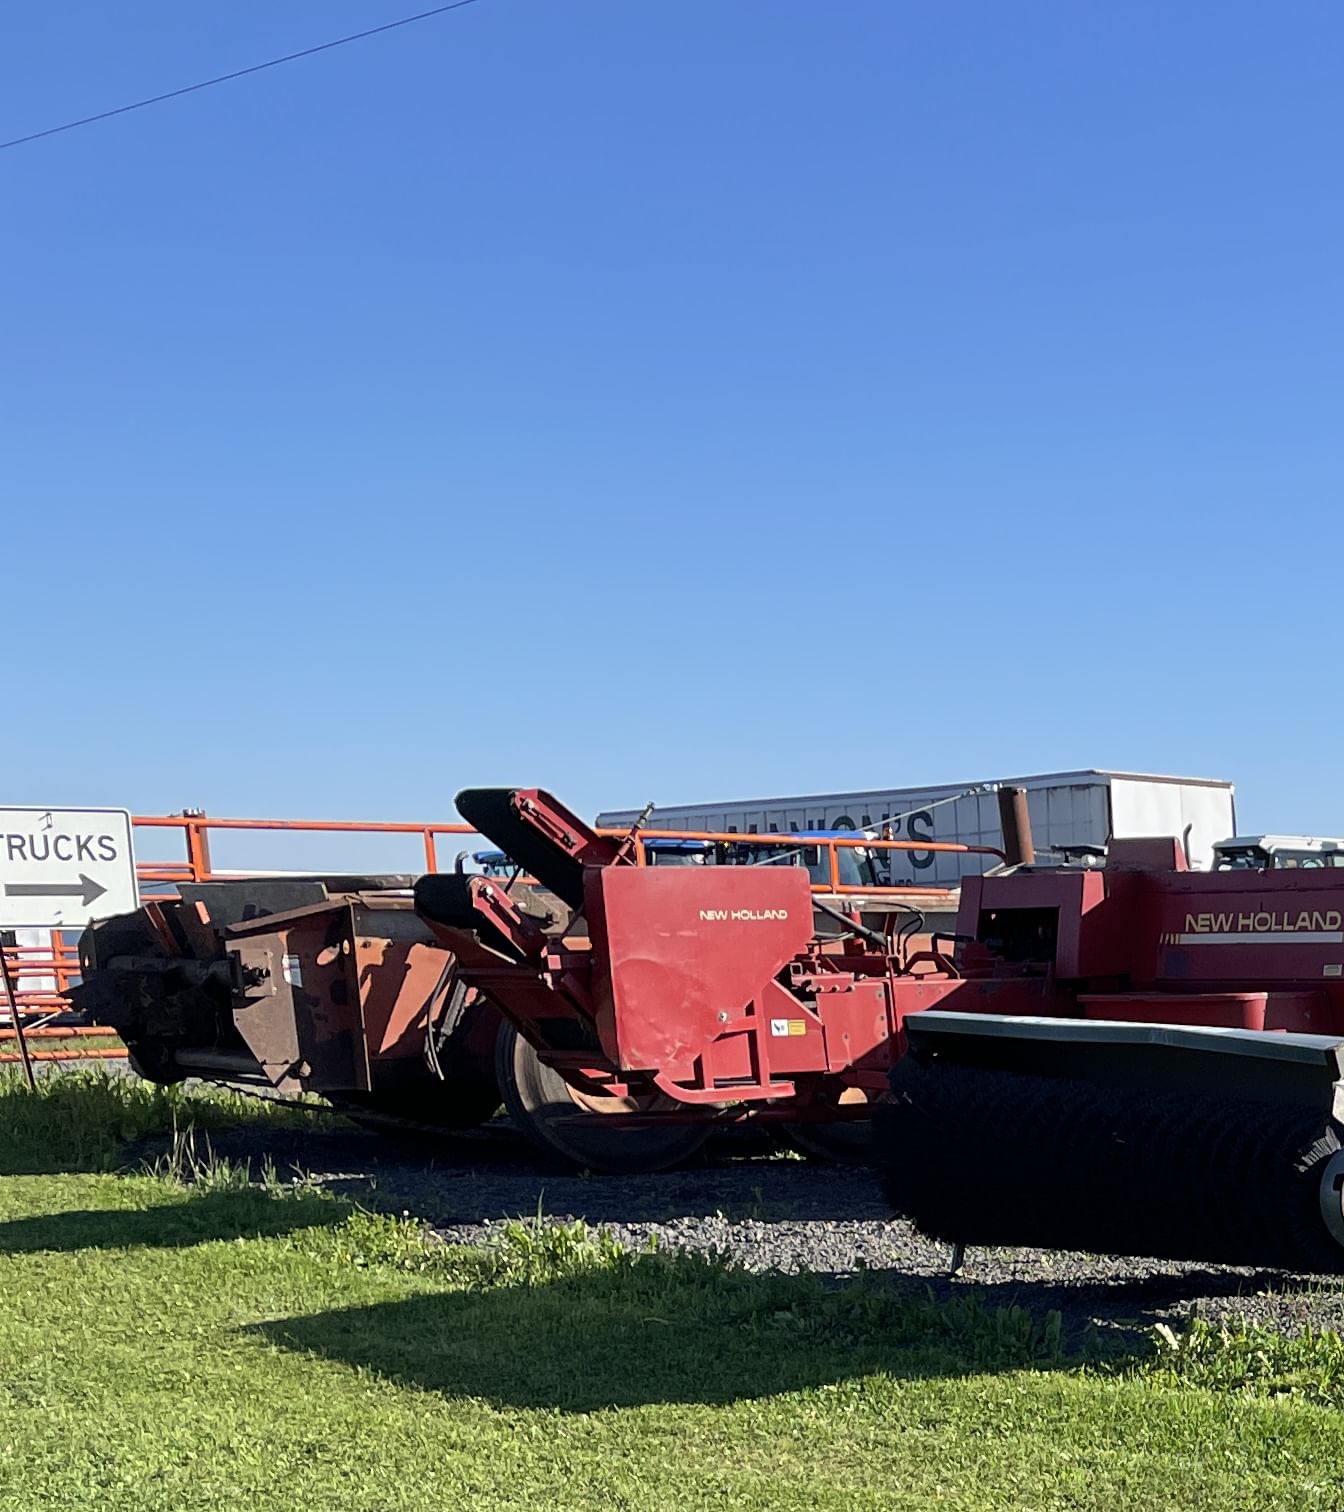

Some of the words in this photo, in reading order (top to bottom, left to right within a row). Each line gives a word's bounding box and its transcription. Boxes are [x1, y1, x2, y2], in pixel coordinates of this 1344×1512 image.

[0, 833, 118, 862] RUCKS
[699, 909, 728, 921] NEW
[731, 909, 788, 921] HOLLAND
[1185, 913, 1233, 932] NEW
[1238, 911, 1342, 932] HOLLAND
